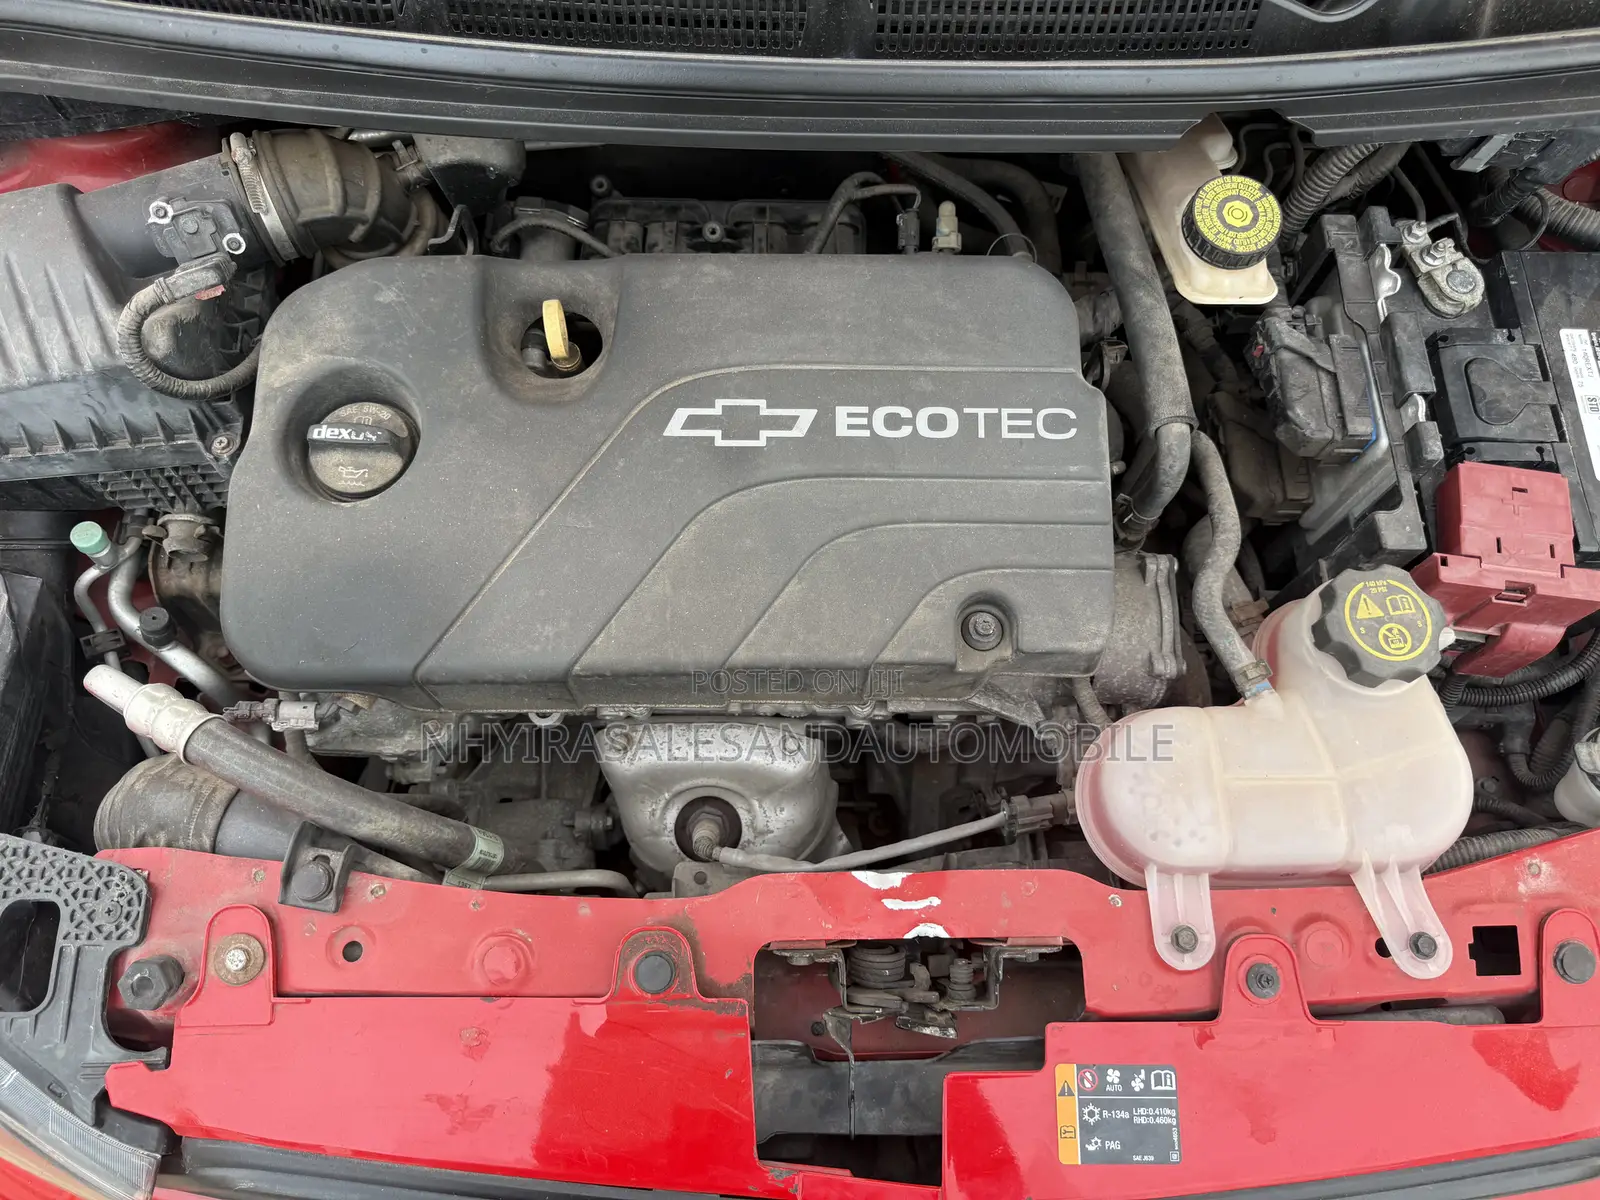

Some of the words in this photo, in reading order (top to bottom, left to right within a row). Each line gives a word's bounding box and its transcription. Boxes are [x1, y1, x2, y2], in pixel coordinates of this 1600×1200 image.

[340, 405, 358, 417] SAE
[363, 405, 391, 420] 5W-20
[835, 406, 1078, 440] ECOTEC
[1102, 1110, 1129, 1119] R-134a
[1105, 1141, 1120, 1150] PAG
